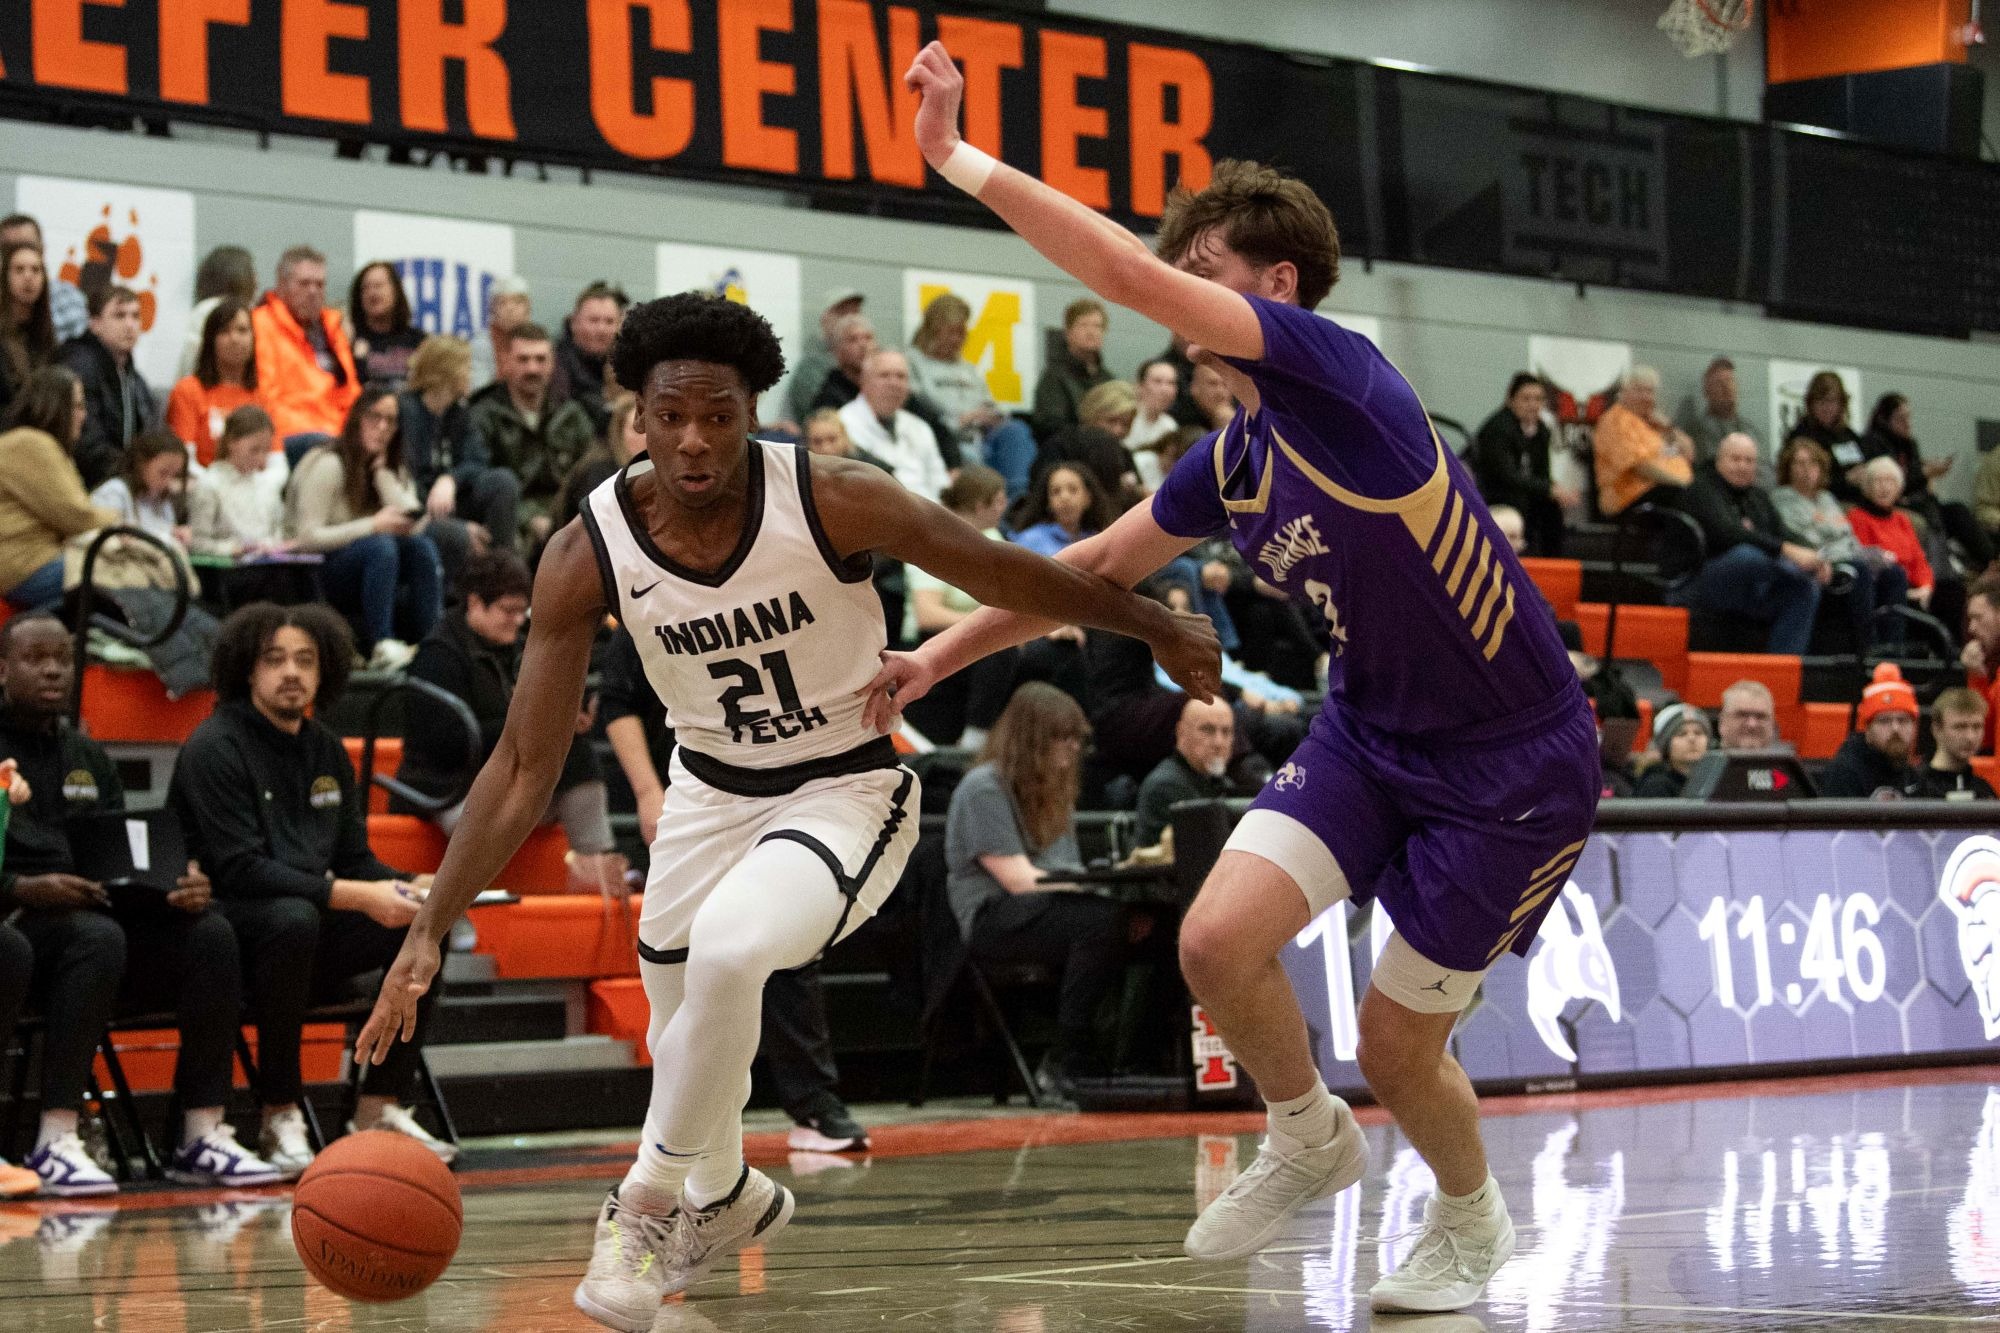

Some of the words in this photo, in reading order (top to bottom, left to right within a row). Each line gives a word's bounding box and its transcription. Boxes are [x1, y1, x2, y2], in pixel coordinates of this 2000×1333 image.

[586, 0, 1215, 217] CENTER
[1519, 150, 1650, 231] TECH
[655, 591, 816, 656] INDIANA
[706, 649, 803, 728] 21
[729, 706, 829, 745] TECH
[1698, 891, 1887, 1009] 11:46
